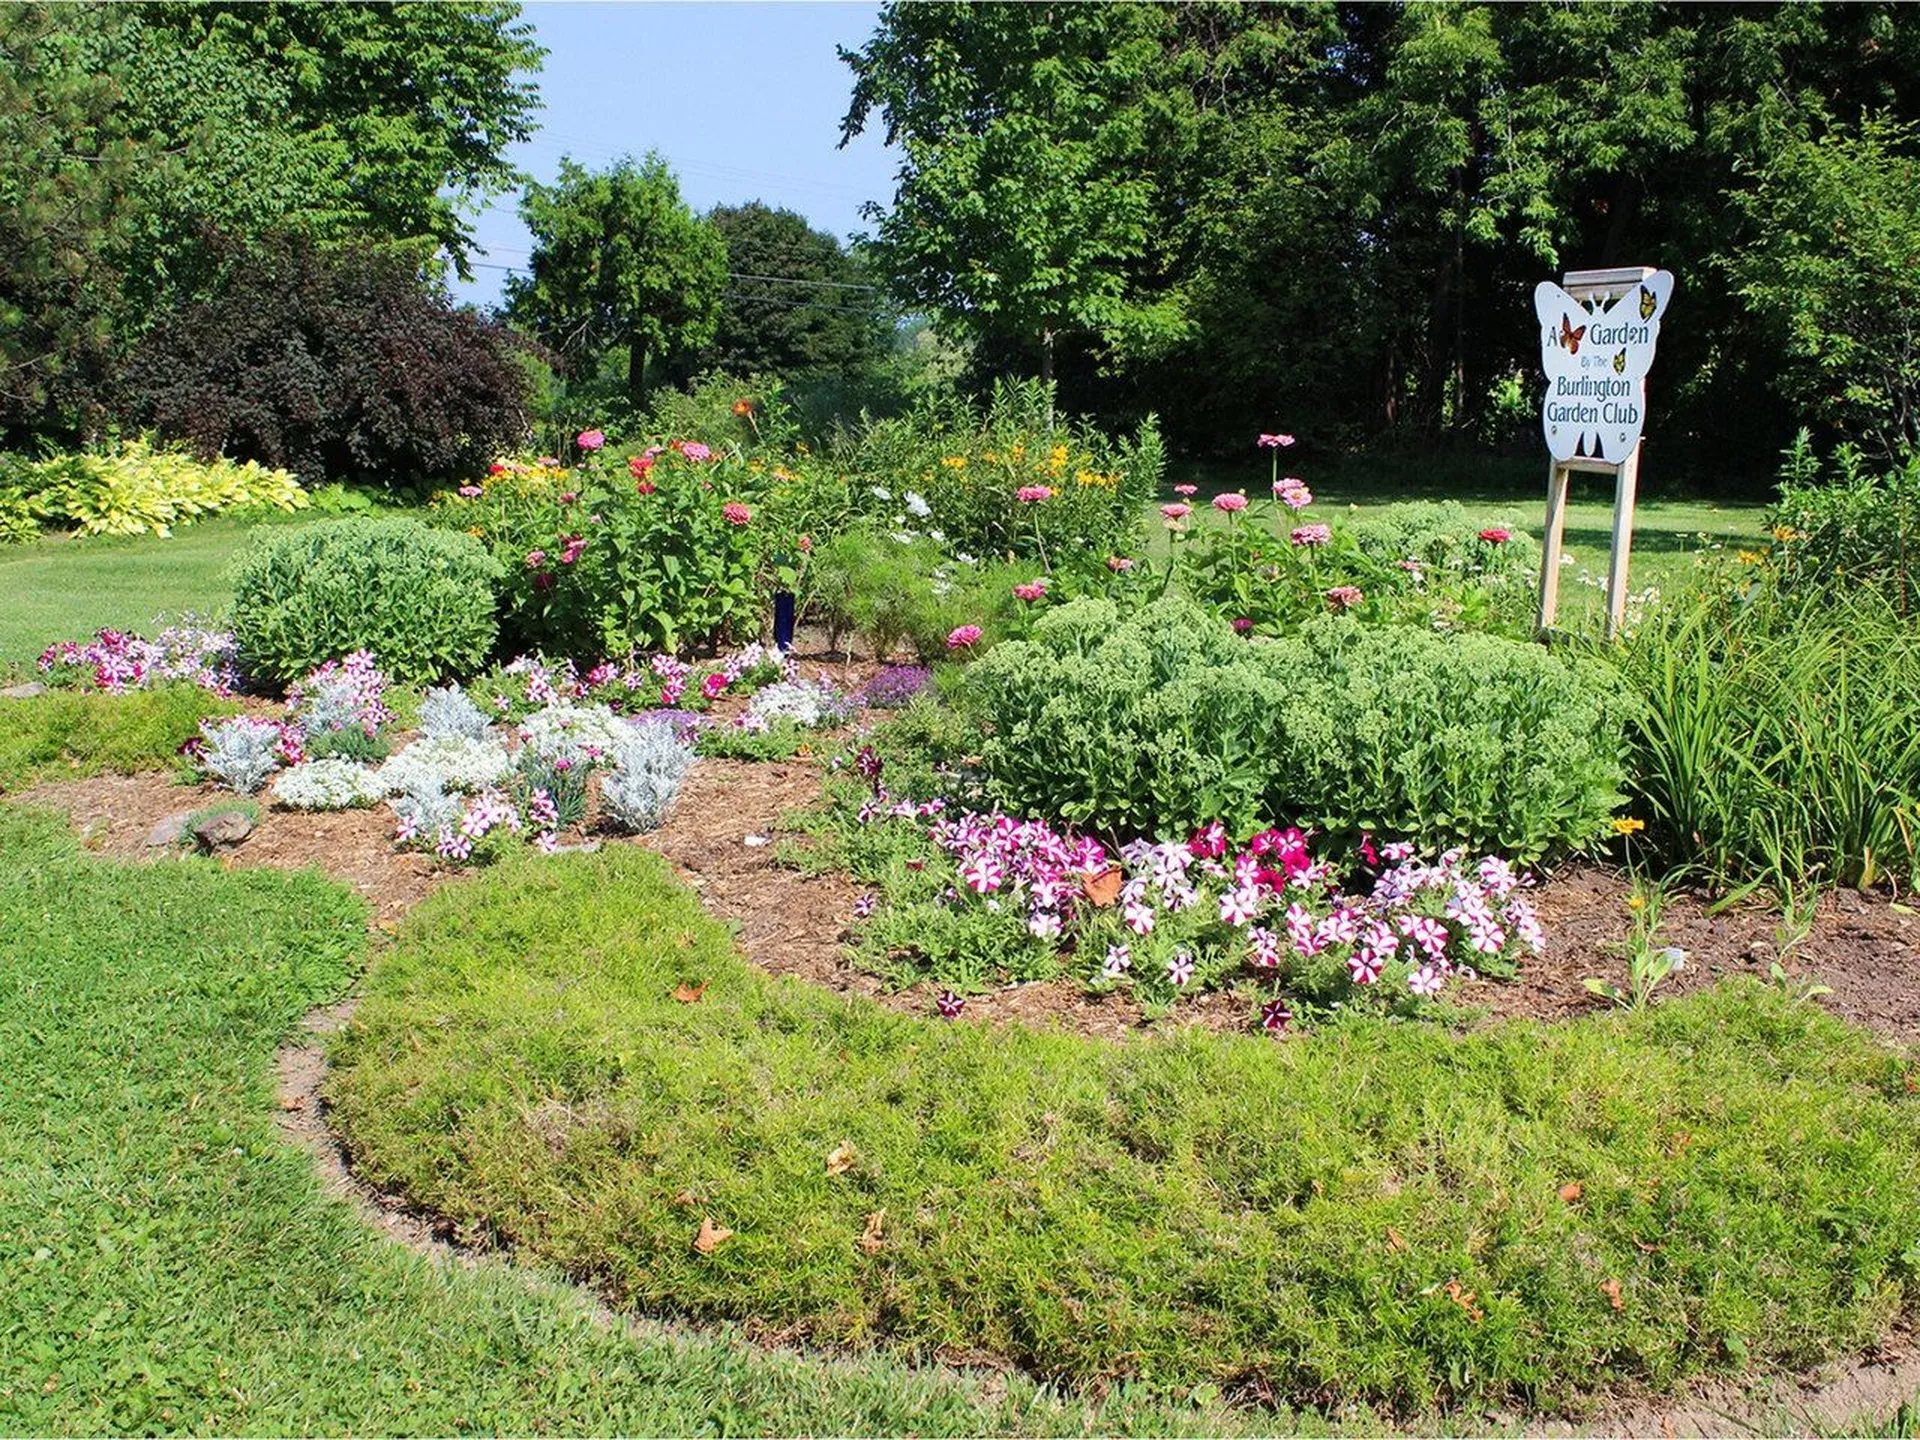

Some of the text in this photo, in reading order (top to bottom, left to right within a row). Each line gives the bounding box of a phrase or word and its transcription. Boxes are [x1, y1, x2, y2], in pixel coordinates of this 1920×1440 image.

[1547, 322, 1649, 347] A Garden
[1557, 375, 1631, 402] Burlington
[1547, 402, 1639, 424] Garden Club
